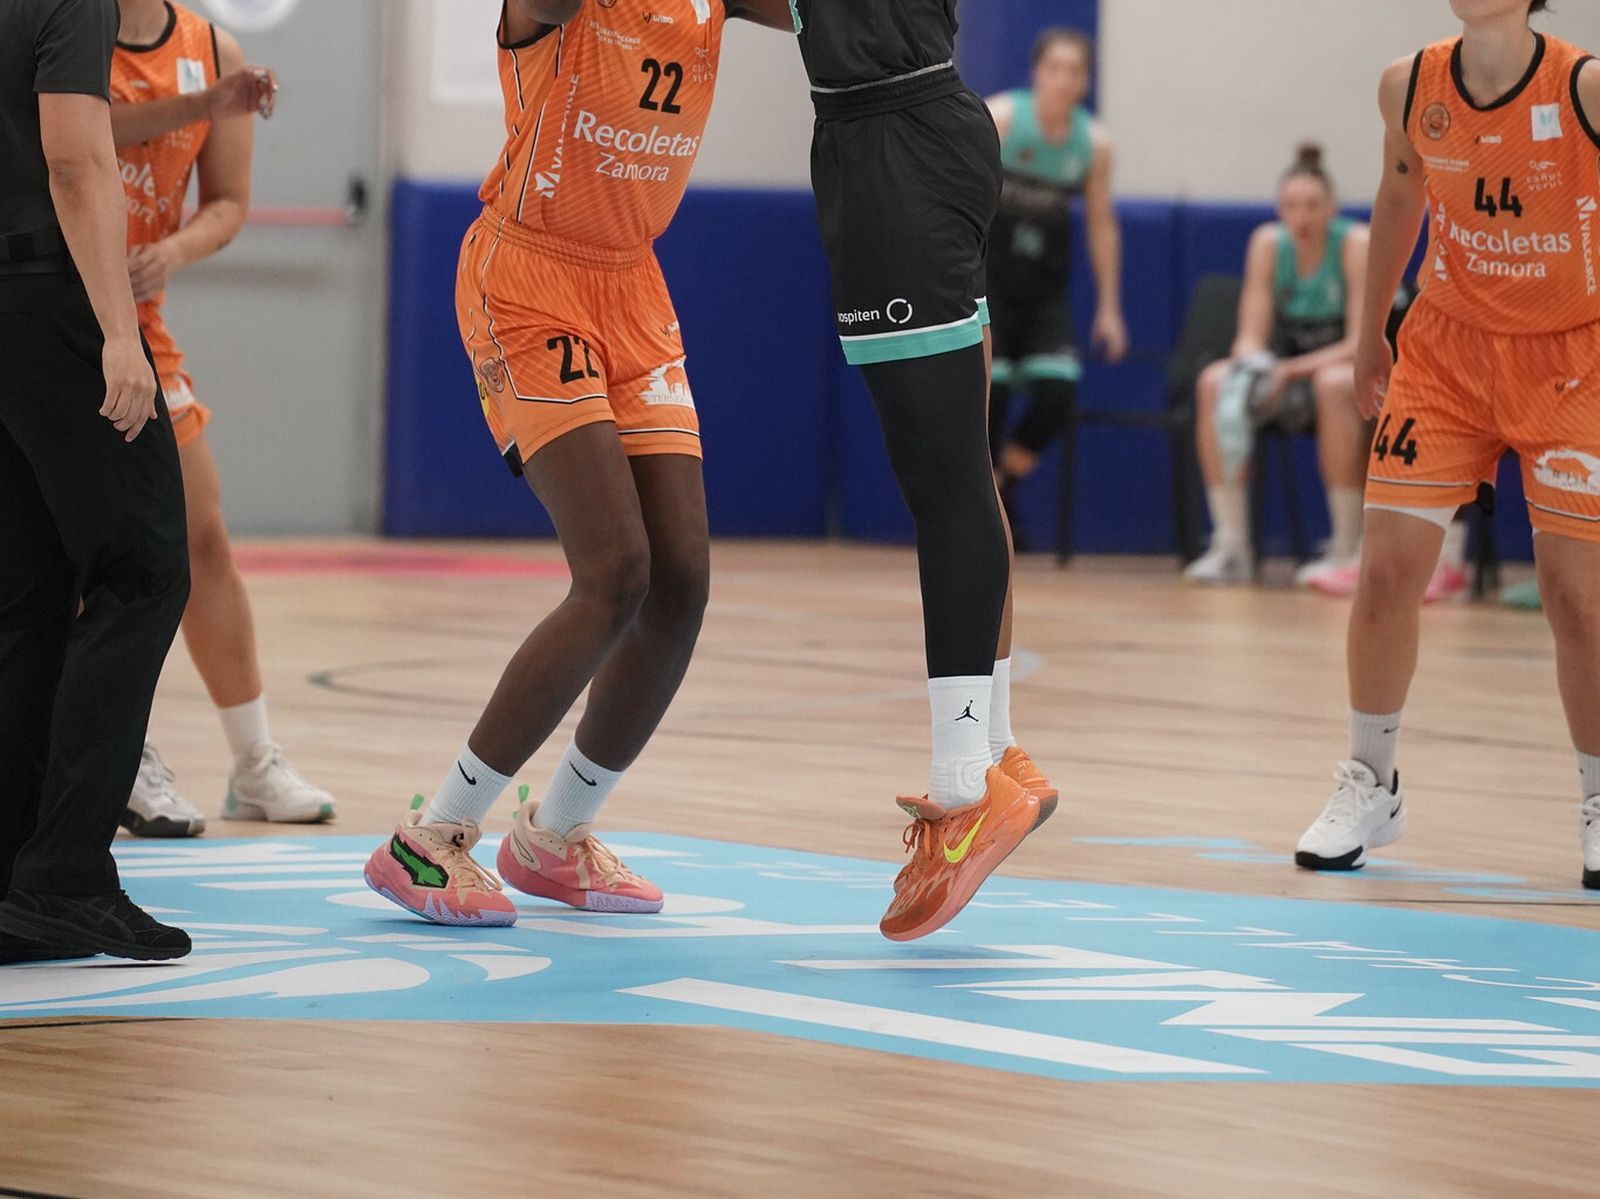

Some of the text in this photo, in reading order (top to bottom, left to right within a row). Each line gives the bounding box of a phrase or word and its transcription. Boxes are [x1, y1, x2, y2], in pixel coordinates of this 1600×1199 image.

[638, 58, 684, 114] 22
[573, 110, 699, 157] Recoletas
[595, 152, 669, 182] Zamora
[1474, 177, 1523, 217] 44
[1465, 252, 1546, 278] Zamora
[1373, 413, 1418, 465] 44
